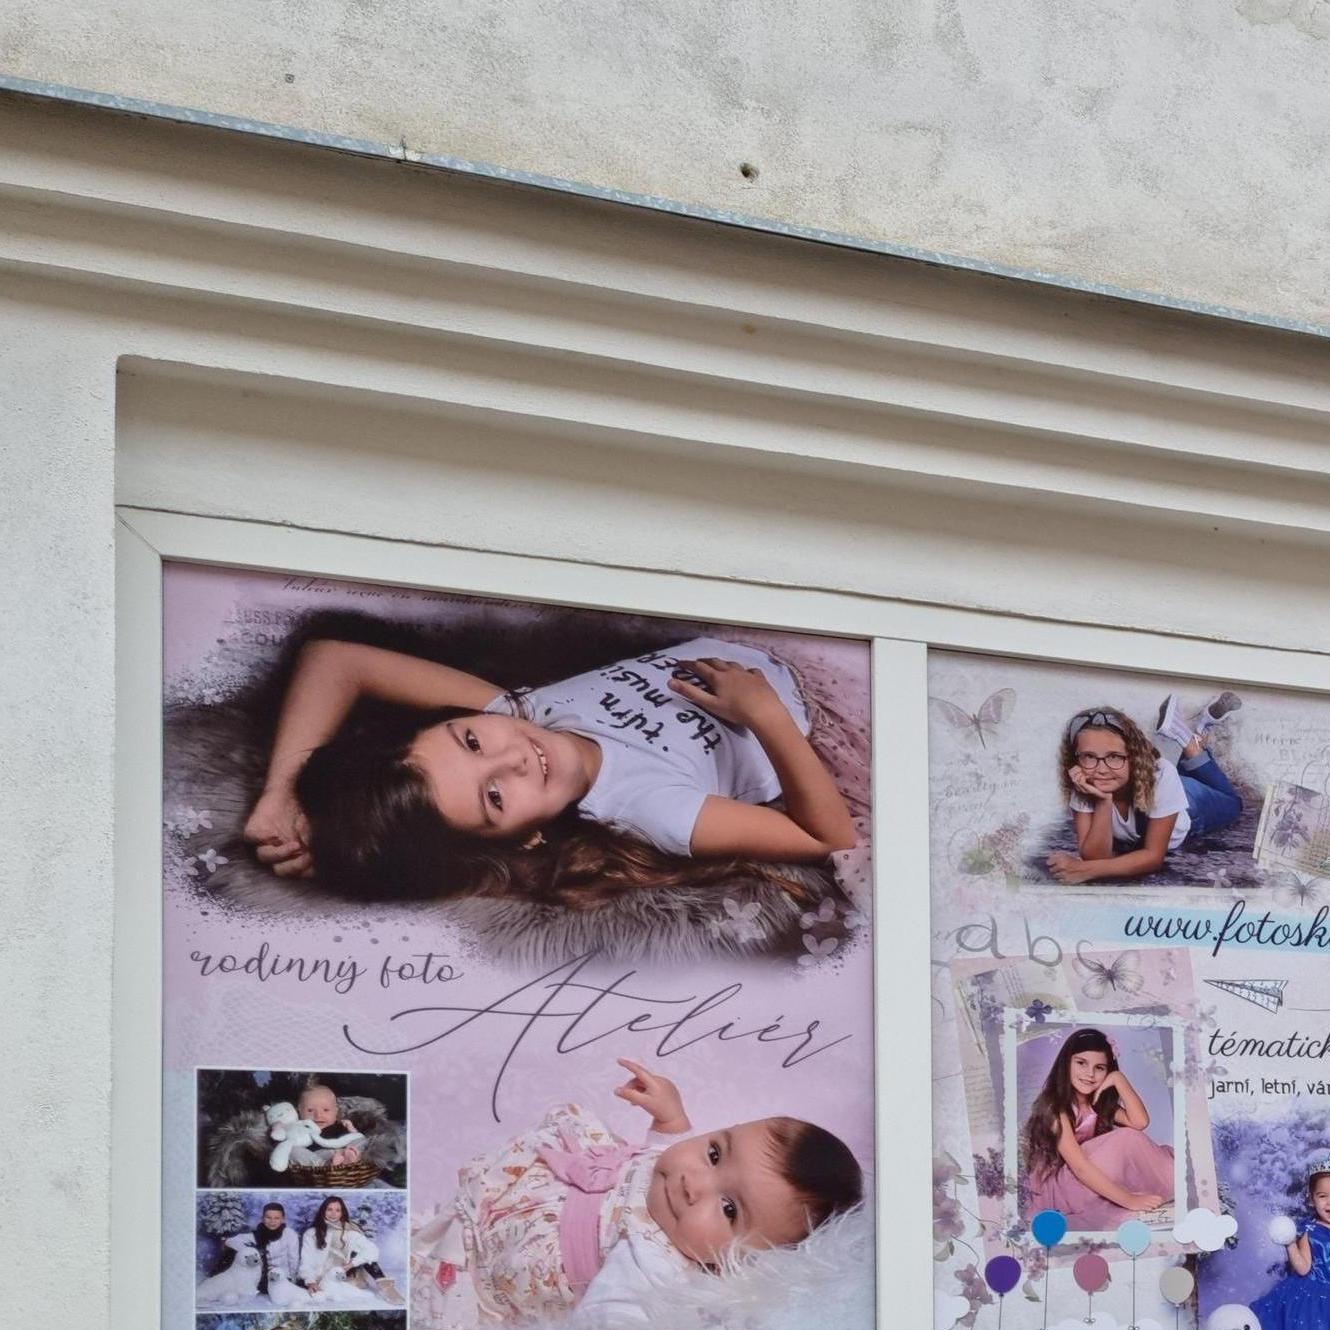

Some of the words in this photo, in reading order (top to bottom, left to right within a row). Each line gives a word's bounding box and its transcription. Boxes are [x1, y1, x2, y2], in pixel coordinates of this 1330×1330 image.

[600, 665, 673, 708] musi
[190, 942, 368, 995] rodinný
[379, 952, 466, 989] foto
